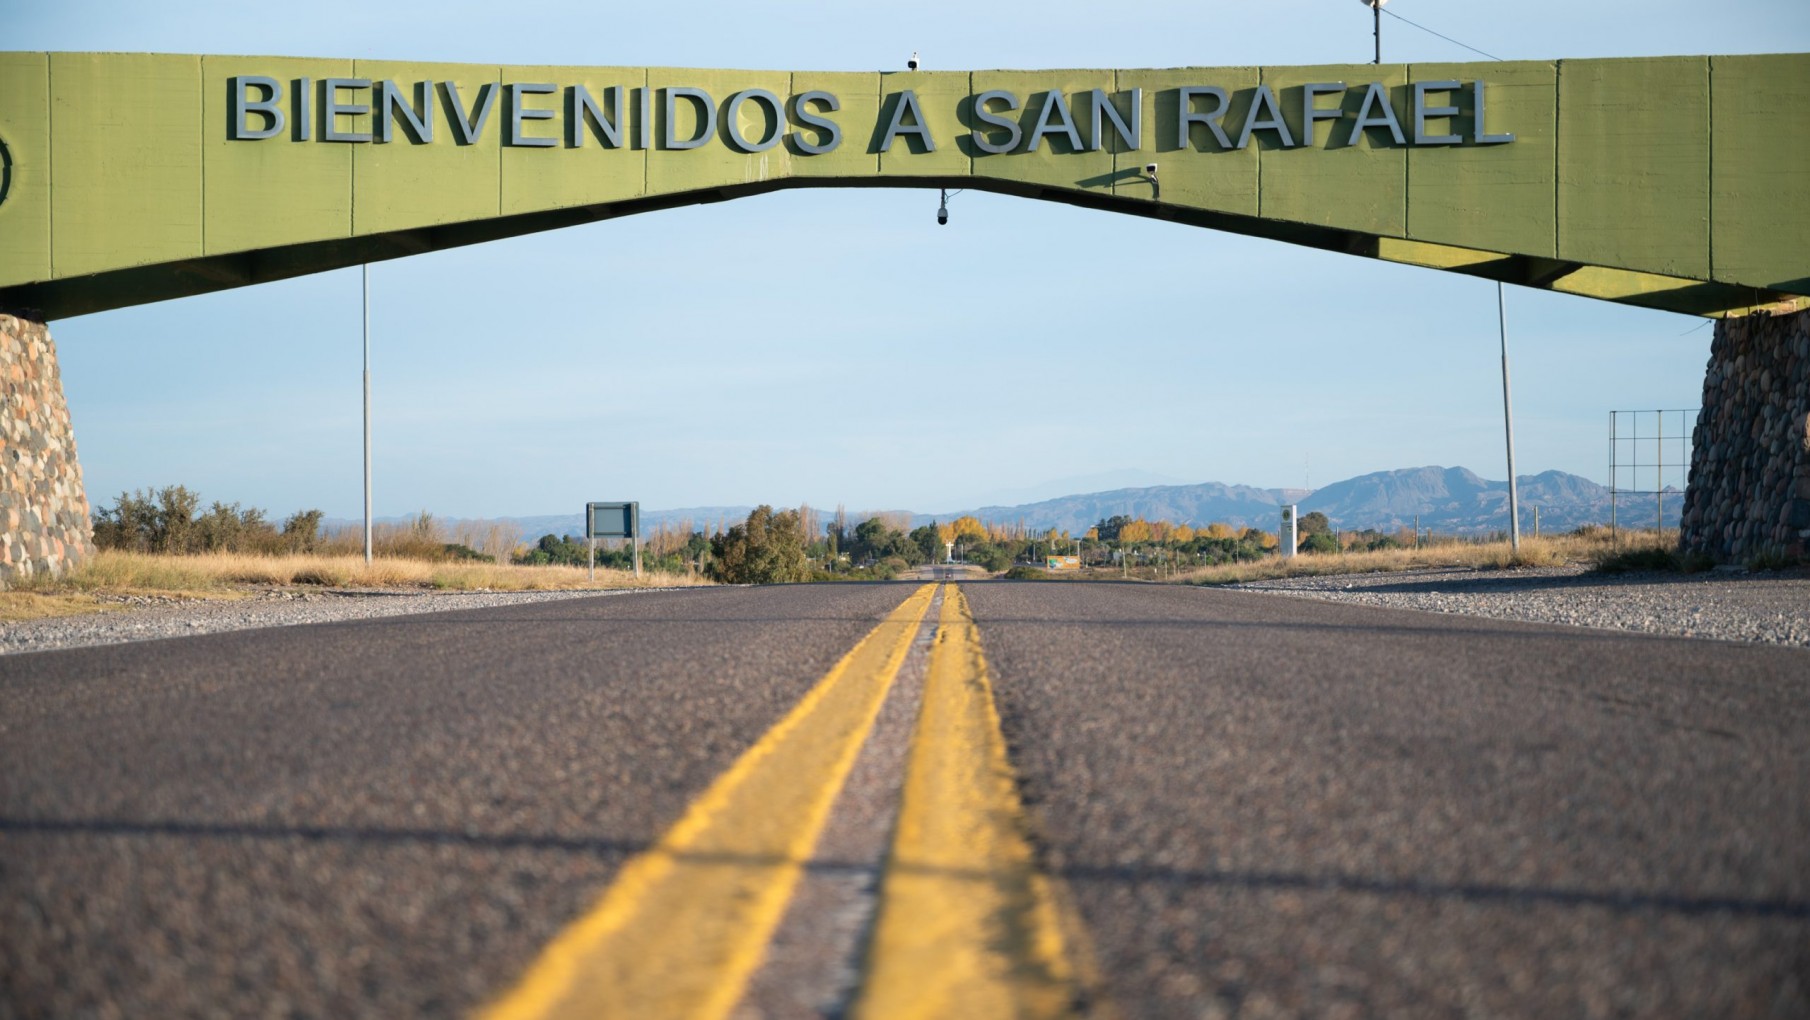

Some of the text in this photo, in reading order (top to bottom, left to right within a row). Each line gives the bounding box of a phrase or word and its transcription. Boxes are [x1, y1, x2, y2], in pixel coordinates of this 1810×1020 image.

[232, 76, 1515, 154] BIENVENIDOS A SAN RAFAEL
